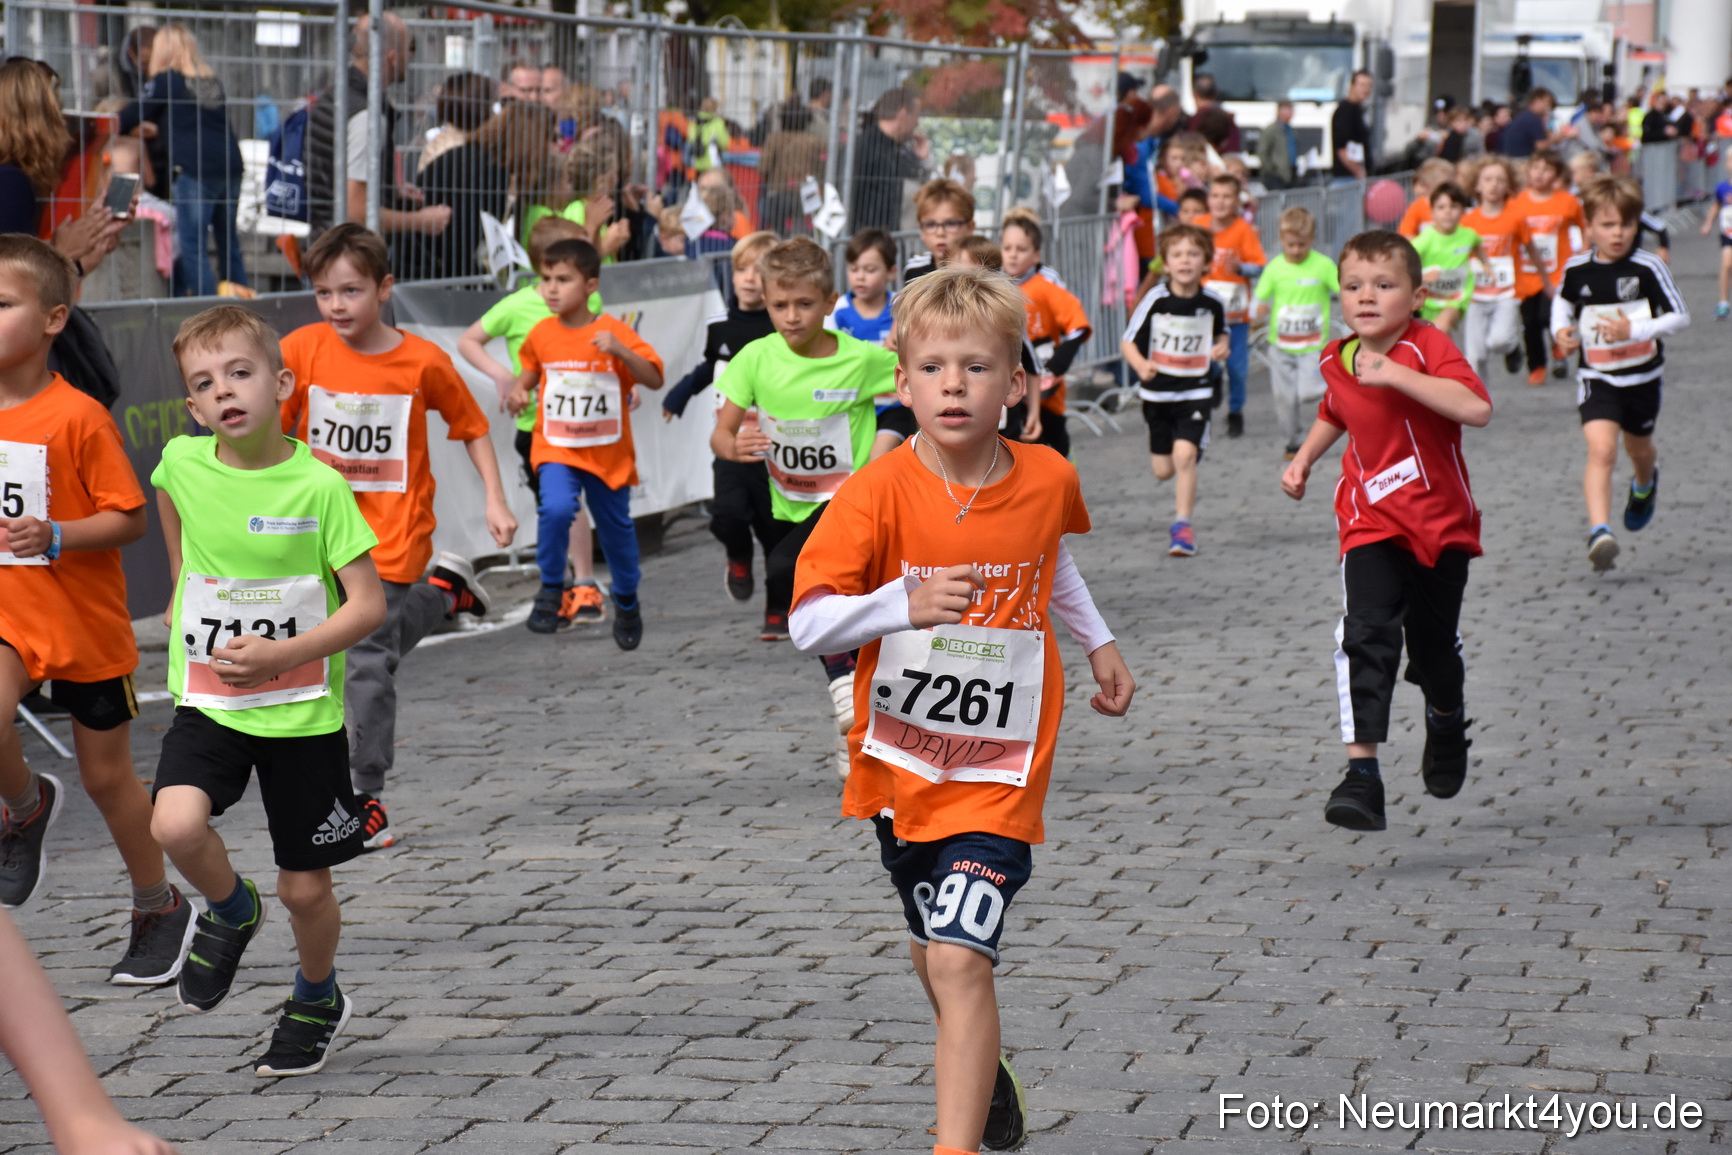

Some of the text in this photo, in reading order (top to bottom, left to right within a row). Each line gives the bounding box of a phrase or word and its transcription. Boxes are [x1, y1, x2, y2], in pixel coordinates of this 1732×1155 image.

[1160, 333, 1203, 352] 7127
[554, 394, 608, 417] 7174
[323, 418, 392, 454] 7005
[331, 459, 380, 475] Sebastian
[771, 440, 838, 471] 7066
[786, 477, 817, 488] Aaron
[1378, 472, 1401, 491] DEHN
[0, 482, 25, 518] 5
[230, 589, 282, 601] BOCK
[947, 638, 1006, 659] BOCK
[899, 668, 1015, 729] 7261
[894, 721, 1006, 767] DAVID
[311, 816, 361, 845] adidas
[952, 859, 1007, 886] RACING
[930, 872, 1004, 941] 90
